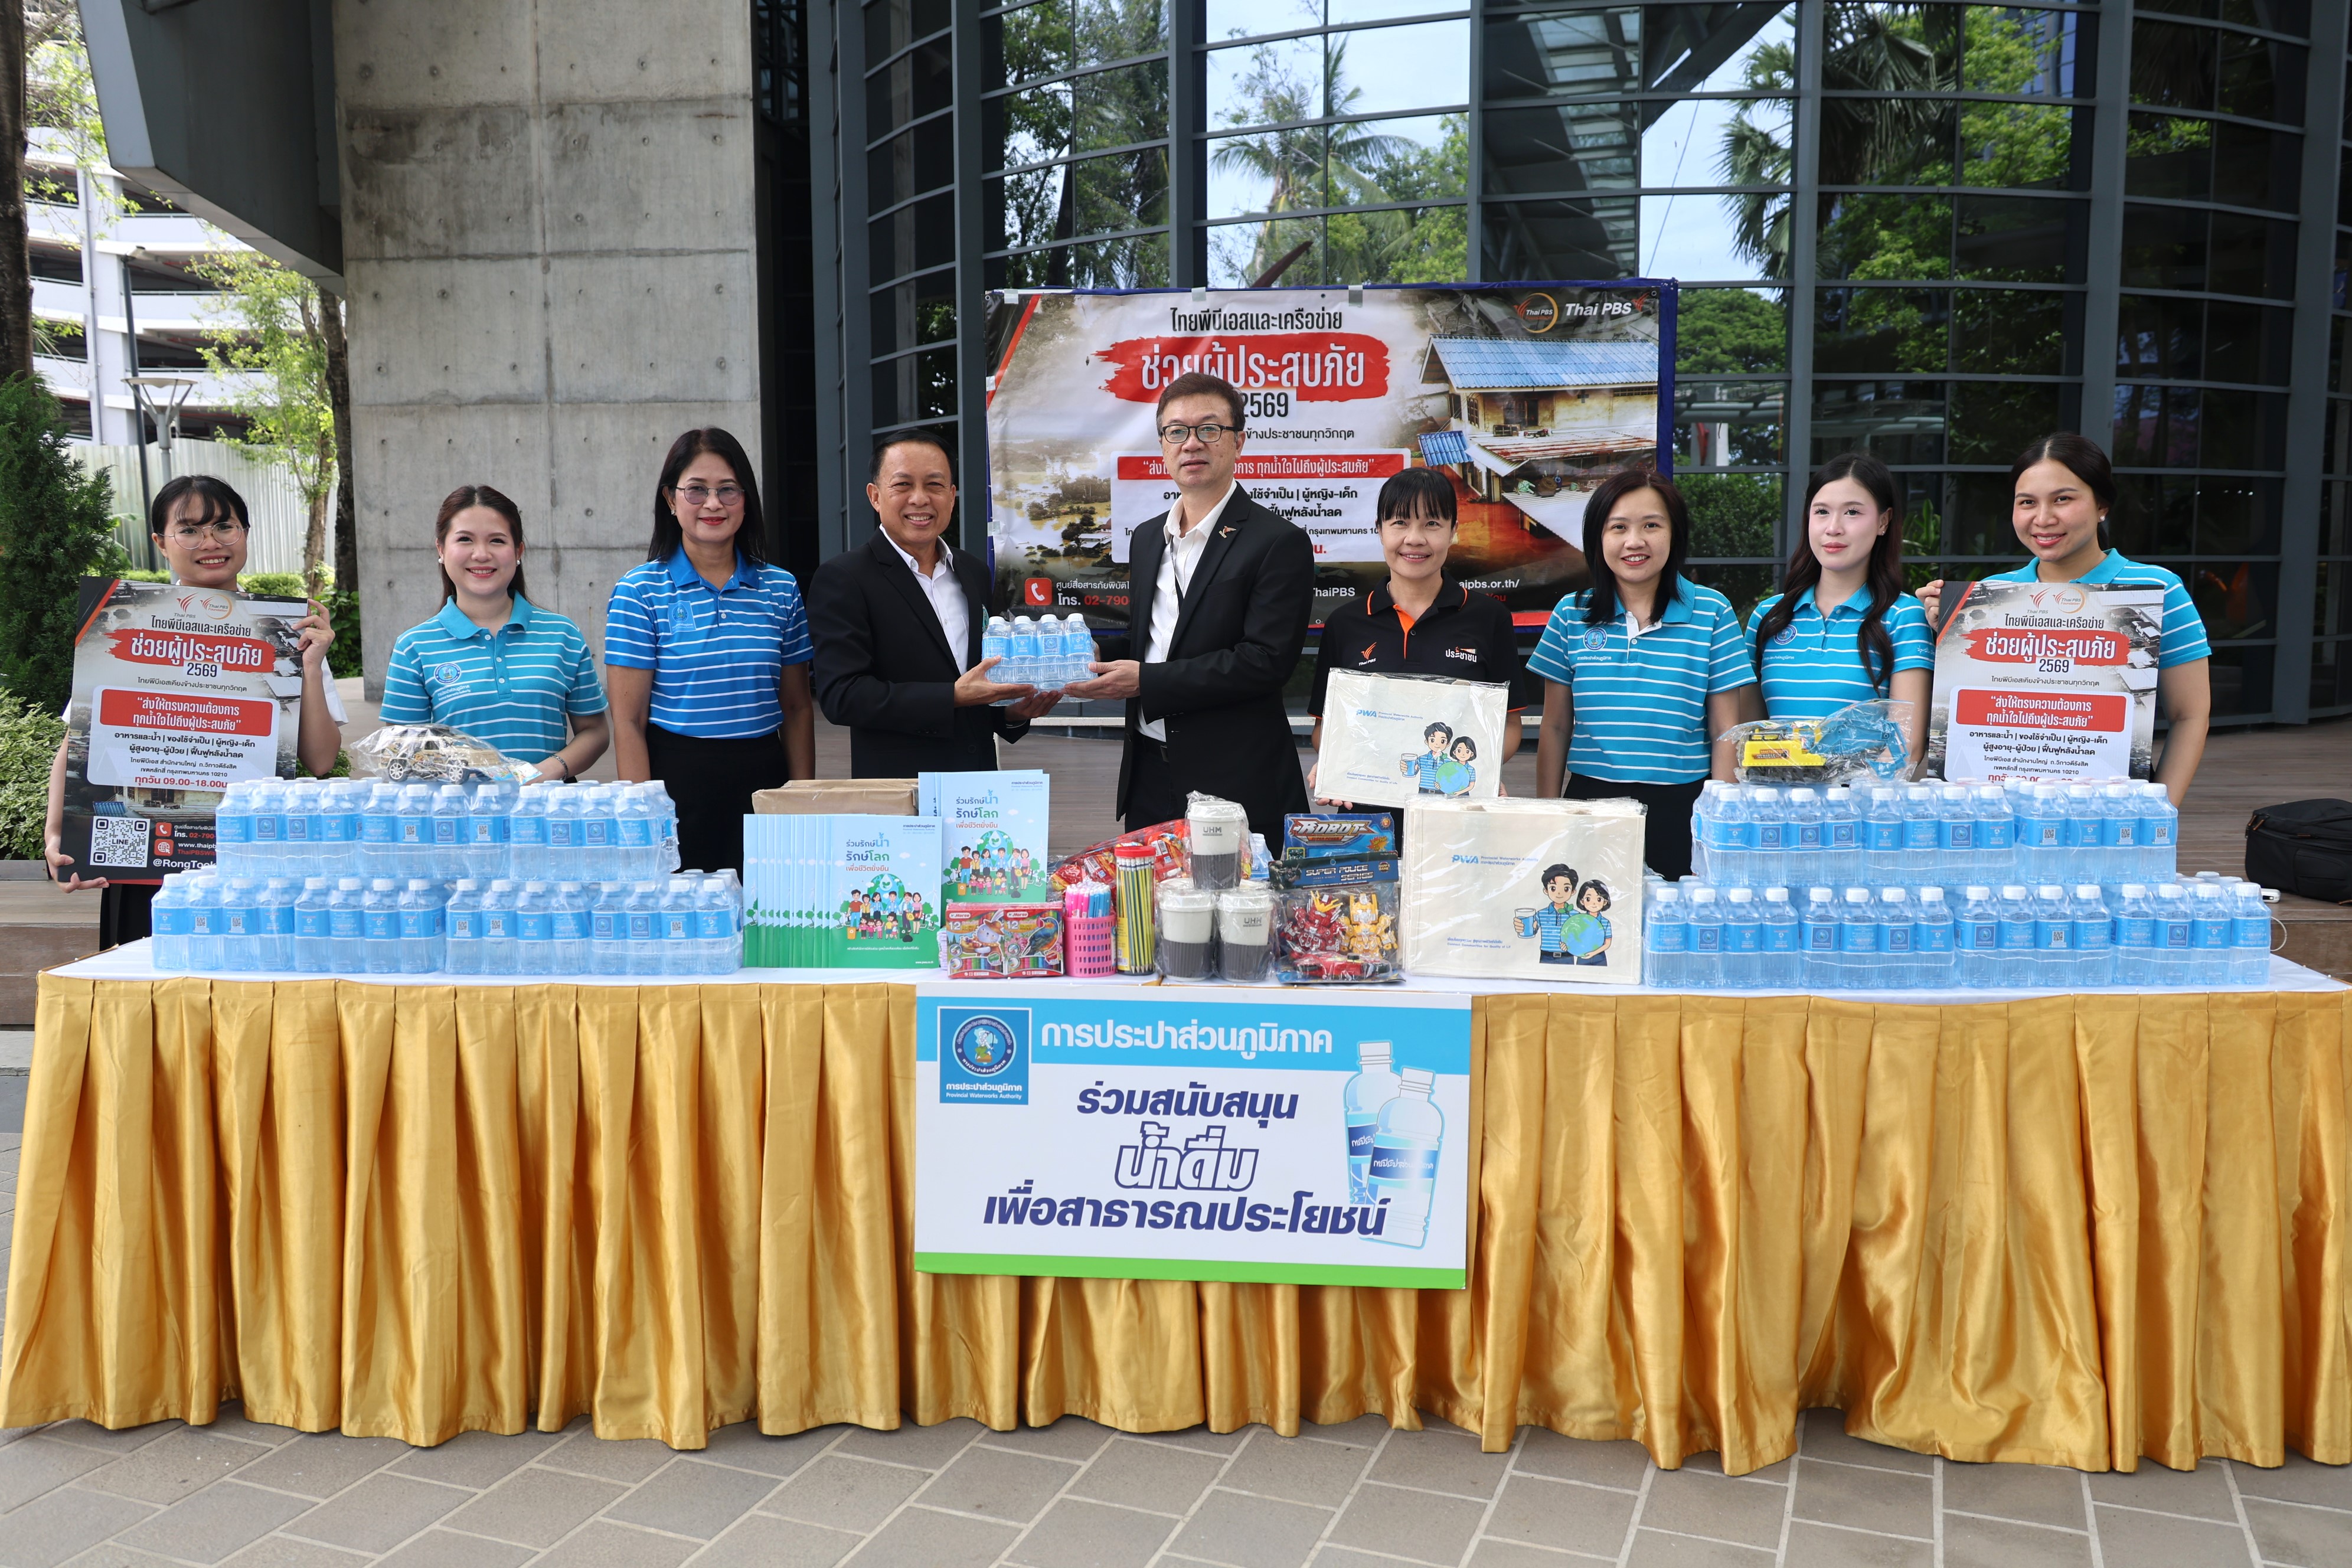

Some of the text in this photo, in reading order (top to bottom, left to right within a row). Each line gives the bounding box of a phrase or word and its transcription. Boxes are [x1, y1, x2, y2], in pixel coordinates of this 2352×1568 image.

[1566, 302, 1632, 316] Thai PBS
[1170, 307, 1342, 331] ไทยพีบีเอสและเครือข่าย
[1141, 341, 1365, 390] ช่วยผ้ประสบภัย
[1246, 427, 1354, 442] ข้างประชาชนทุกวิกฤต
[1257, 456, 1374, 477] ทุกน้ำใจไปถึงผู้ประสบภัย”
[1309, 527, 1367, 537] กรุงเทพมหานคร
[1056, 579, 1129, 591] ศูนย์สื่อสารภัยพิบัติไ
[1459, 579, 1520, 590] aipbs.or.th/
[1313, 587, 1355, 597] haiPBS
[1058, 593, 1130, 606] โทร. 02-790
[151, 615, 251, 637] ไทยพีบีเอสและเครือข่าย
[2005, 613, 2104, 629] ไทยพีบีเอสและเครือข่าย
[130, 632, 262, 666] ช่วยผู้ประสบภัย
[1985, 631, 2116, 662] ช่วยผู้ประสบภัย
[1445, 649, 1477, 663] ประชาชน
[187, 662, 218, 678] 2569
[2039, 658, 2069, 673] 2569
[138, 677, 247, 692] ไทยพีบีเอสเคียงข้างประชาชนทุกวิกฤต
[1991, 675, 2100, 687] ไทยพีบีเอสเคียงข้างประชาชนทุกวิกฤต
[1356, 709, 1377, 718] PWA
[115, 731, 161, 741] อาหารและน้ำ
[167, 736, 210, 745] ของใช้จำเป็น
[1969, 730, 2013, 739] อาหารและน้ำ
[2019, 733, 2062, 741] ของใช้จำเป็น
[190, 747, 243, 759] ฟื้นฟูหลังน้ำลด
[2042, 743, 2095, 756] ฟื้นฟูหลังน้ำลด
[2012, 757, 2048, 765] สำนักงานใหญ่
[135, 775, 228, 788] ทุกวัน 09.00-18.00น
[956, 789, 998, 805] ร่วมรักษ์น้ำ
[956, 807, 998, 818] รักษ์โลก
[956, 820, 998, 828] เพื่อชีวิตยั่งยืน
[1298, 821, 1366, 834] ROBOT
[846, 832, 890, 847] ร่วมรักษ์น้ำ
[846, 850, 890, 861] รักษ์โลก
[1452, 855, 1479, 864] PWA
[846, 863, 889, 871] เพื่อชีวิตยั่งยืน
[1305, 864, 1368, 876] SUPER POLICE
[1341, 872, 1374, 881] SERIES
[949, 922, 961, 930] 12
[1007, 921, 1019, 930] 12
[1041, 1017, 1332, 1060] การประปาส่วนภูมิภาค
[946, 1083, 1023, 1093] การประปาส่วนภูมิภาค
[1076, 1080, 1298, 1128] ร่วมสนับสนุน
[1115, 1121, 1259, 1191] น้ำดื่ม
[984, 1179, 1389, 1236] เพื่อสาธารณประโยชน์
